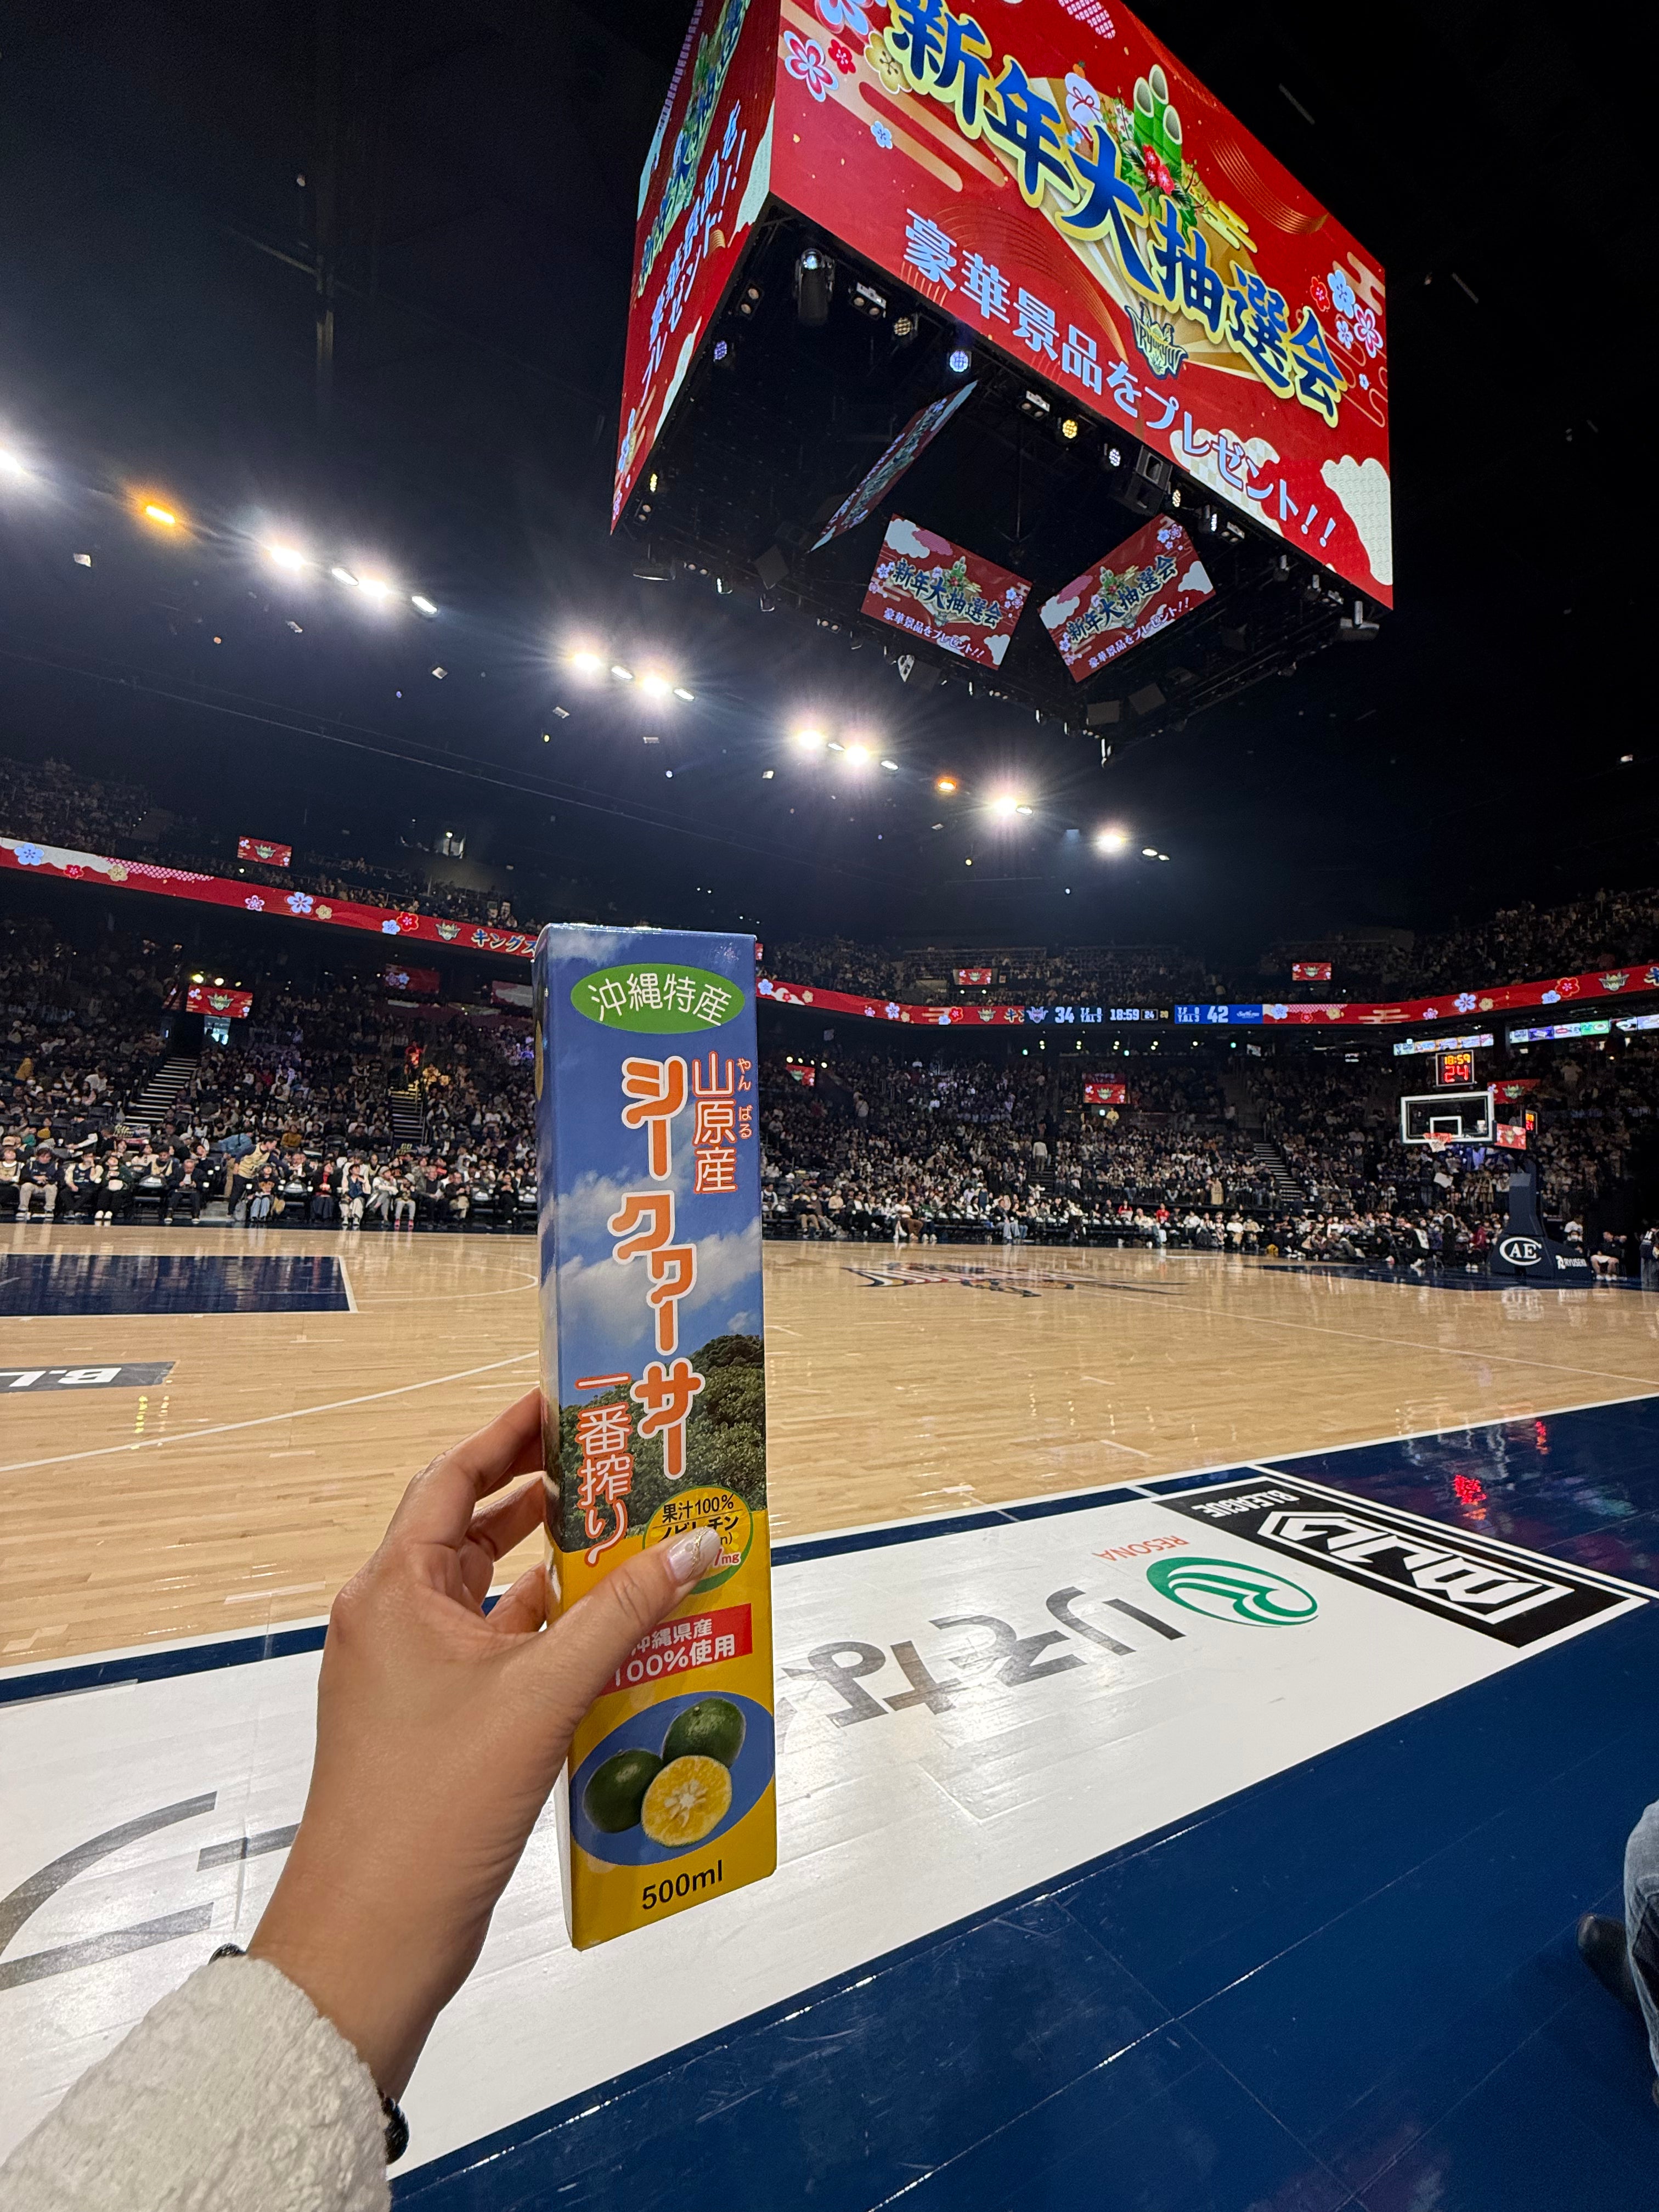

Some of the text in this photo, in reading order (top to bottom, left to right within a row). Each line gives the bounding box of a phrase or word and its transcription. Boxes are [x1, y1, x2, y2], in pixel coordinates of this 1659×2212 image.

[883, 0, 1347, 428] 新年大抽選会
[903, 208, 1336, 546] 豪華景品をプレゼント!!
[892, 557, 1003, 629] 新年大抽選会
[1067, 555, 1177, 643] 新年大抽選会
[588, 972, 732, 1026] 沖縄特産
[1054, 1007, 1075, 1023] 34
[1110, 1008, 1139, 1021] 18:59
[1144, 1011, 1154, 1019] 24
[1207, 1006, 1229, 1023] 42
[1444, 1053, 1471, 1065] 18:59
[1444, 1064, 1469, 1083] 24
[692, 1051, 738, 1194] 山原産
[575, 1373, 634, 1567] 一番搾り
[658, 1516, 739, 1543] ノビチン
[662, 1493, 734, 1523] 果汁100%
[1092, 1536, 1189, 1561] RESONA
[615, 1634, 735, 1686] 100%使用
[775, 1587, 1186, 1753] りそな
[642, 1860, 723, 1910] 500ml
